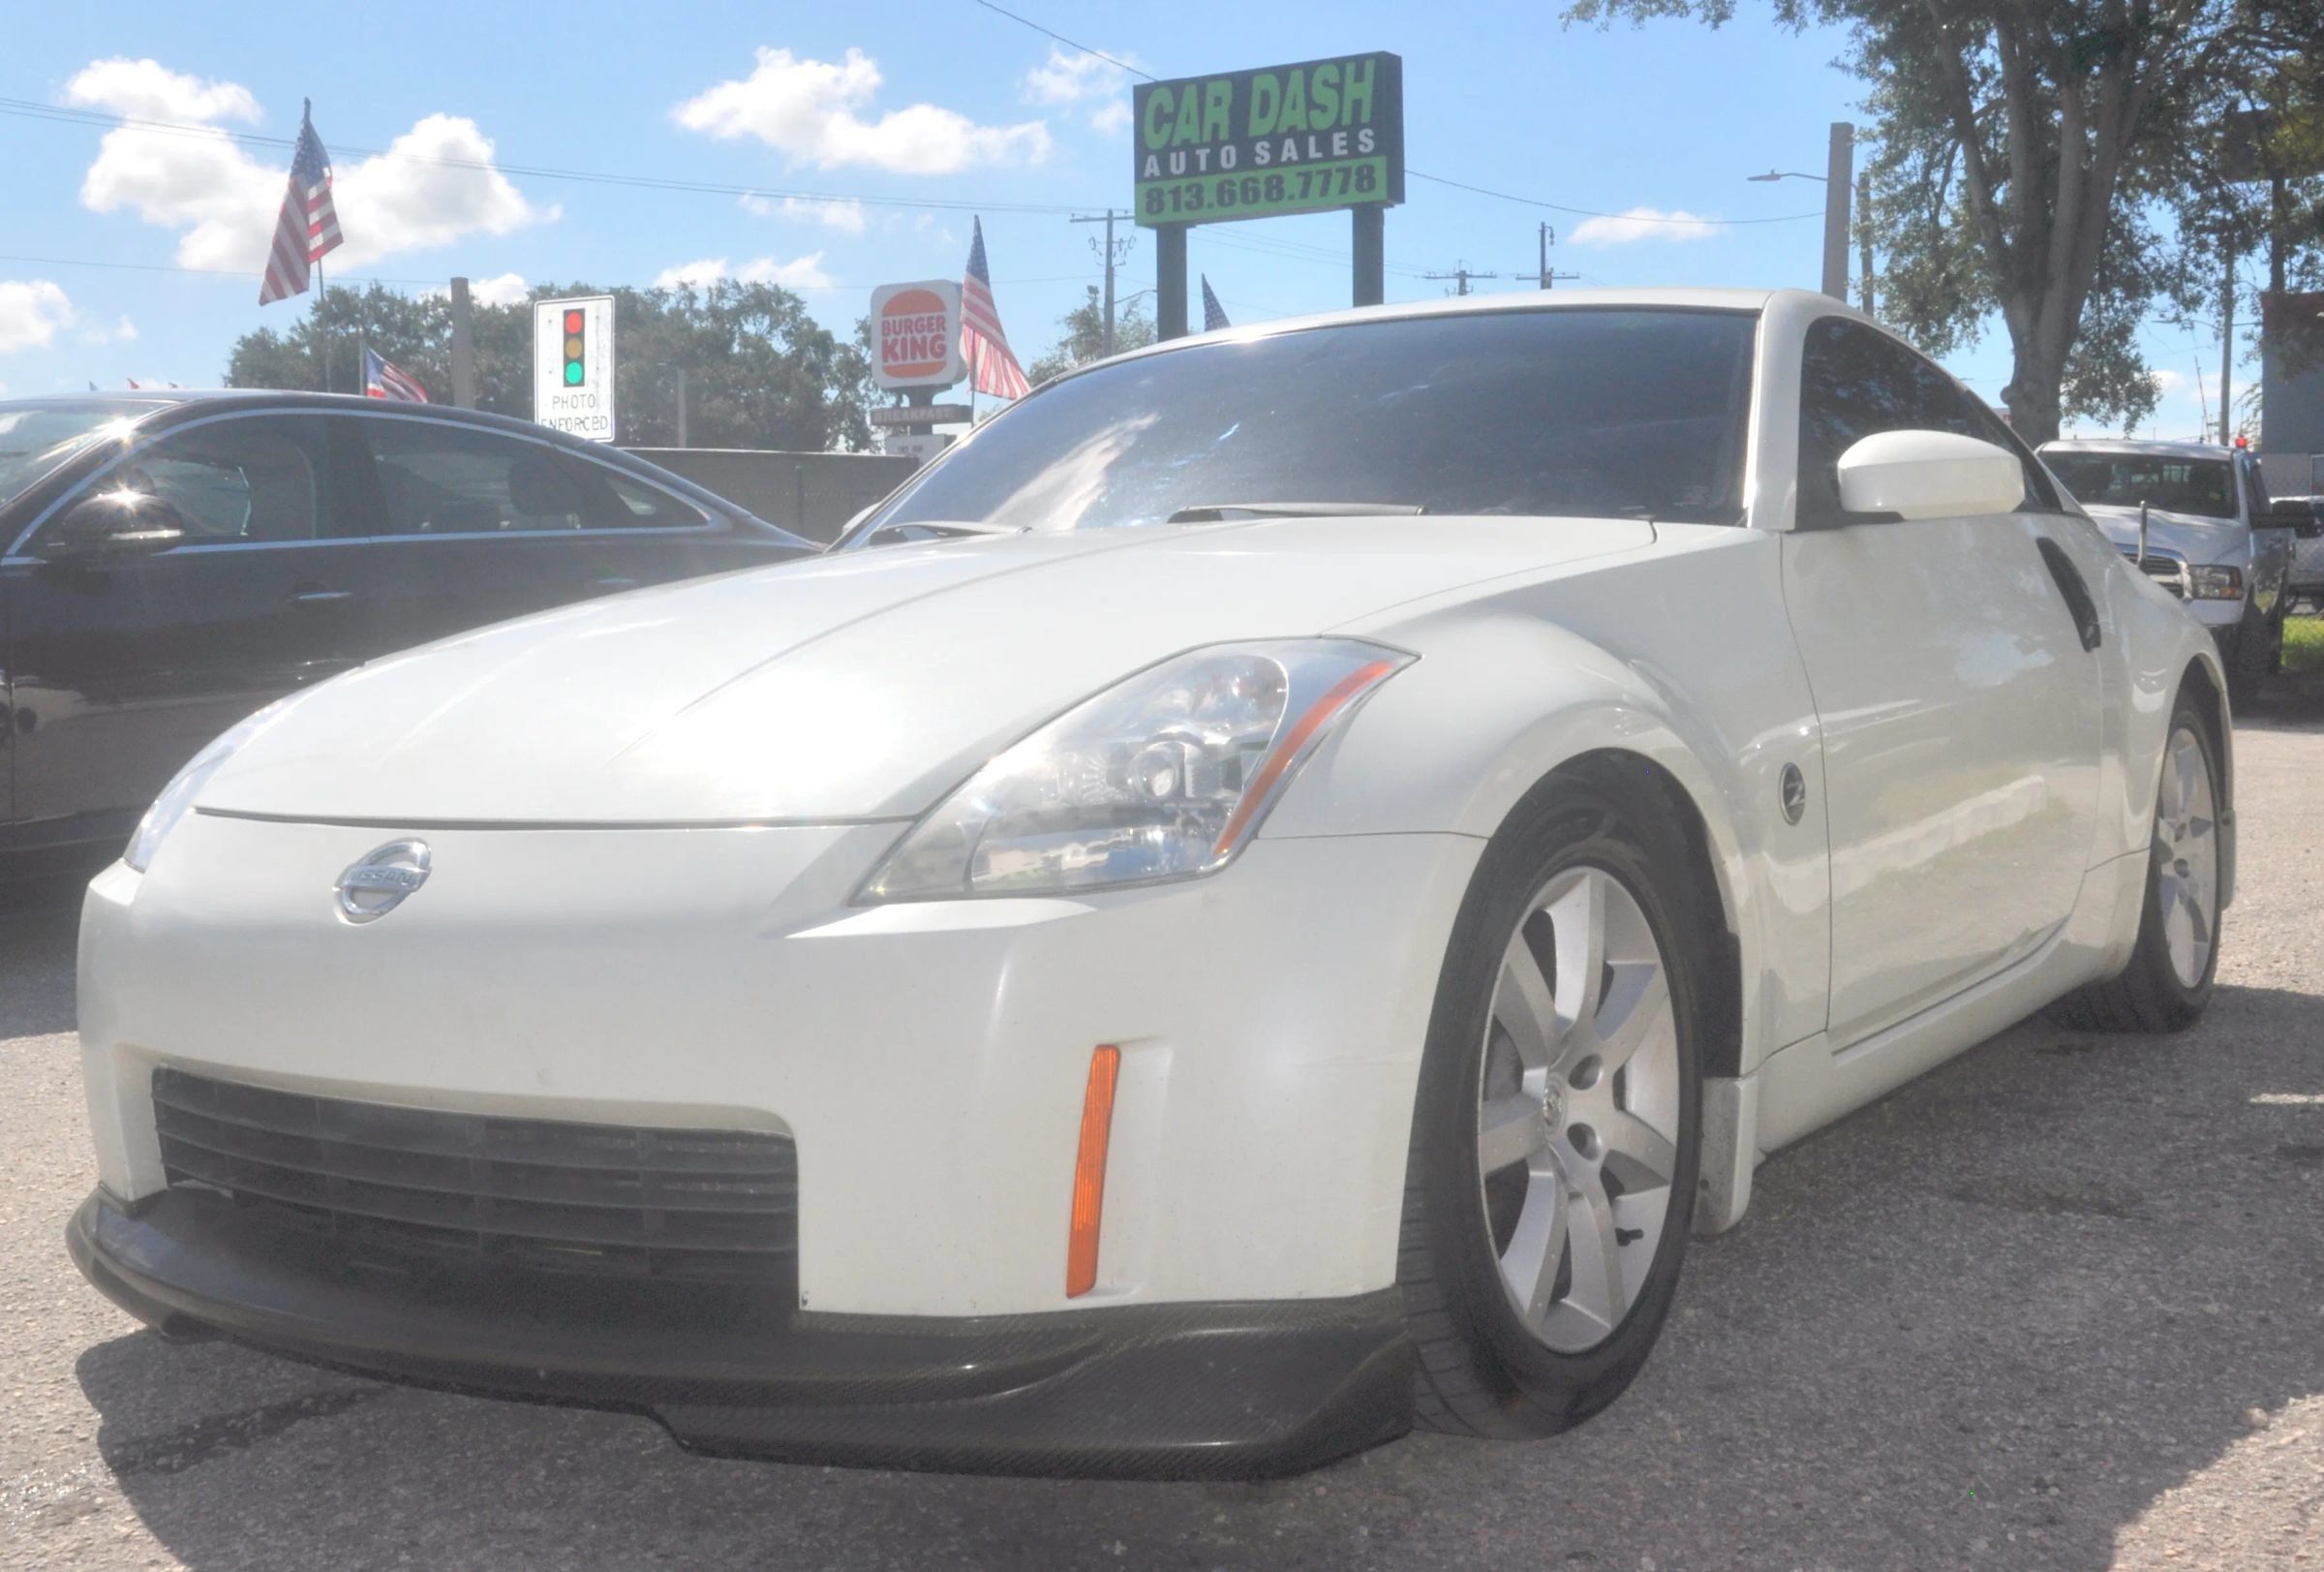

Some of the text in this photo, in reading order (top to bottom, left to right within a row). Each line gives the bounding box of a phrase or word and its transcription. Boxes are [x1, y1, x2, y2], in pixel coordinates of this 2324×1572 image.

[1144, 59, 1375, 149] CAR DASH
[1145, 129, 1374, 177] AUTO SALES
[1146, 164, 1376, 215] 813.668.7778
[881, 315, 946, 336] BURGER
[882, 333, 947, 363] KING
[552, 393, 596, 410] PHOTO
